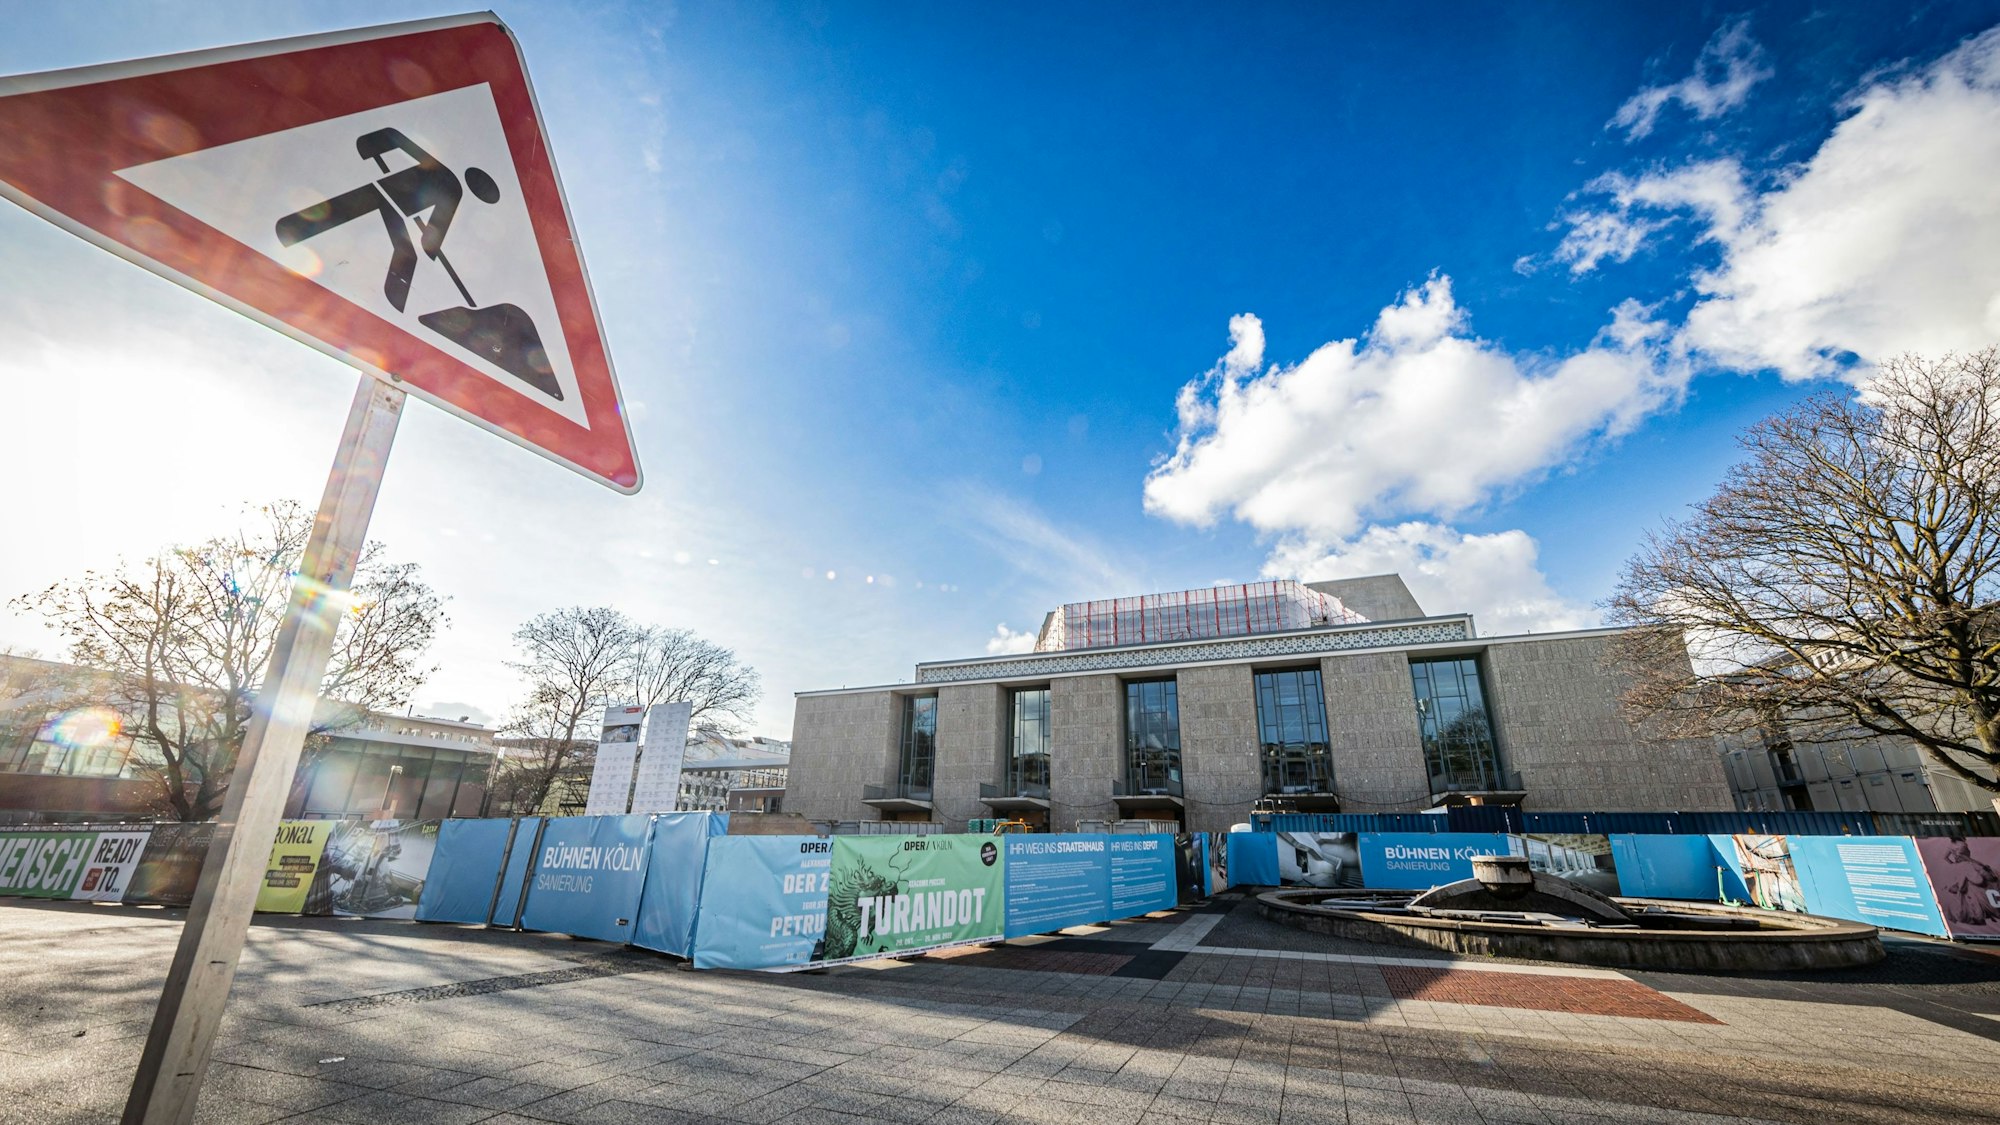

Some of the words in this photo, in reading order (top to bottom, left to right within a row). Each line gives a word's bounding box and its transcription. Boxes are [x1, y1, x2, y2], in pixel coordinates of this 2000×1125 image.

[94, 839, 142, 863] READY
[1009, 843, 1024, 855] IHR
[1025, 842, 1044, 854] WEG
[1045, 842, 1057, 854] INS
[1057, 841, 1104, 853] STAATENHAUS
[1143, 840, 1158, 850] DEPOT
[1385, 845, 1450, 860] BÜHNEN
[543, 841, 602, 870] BÜHNEN
[602, 842, 644, 871] KÖLN
[1387, 861, 1450, 871] SANIERUNG
[537, 874, 593, 893] SANIERUNG
[784, 873, 816, 894] DER
[858, 887, 985, 937] TURANDOT
[770, 913, 825, 938] PETRU
